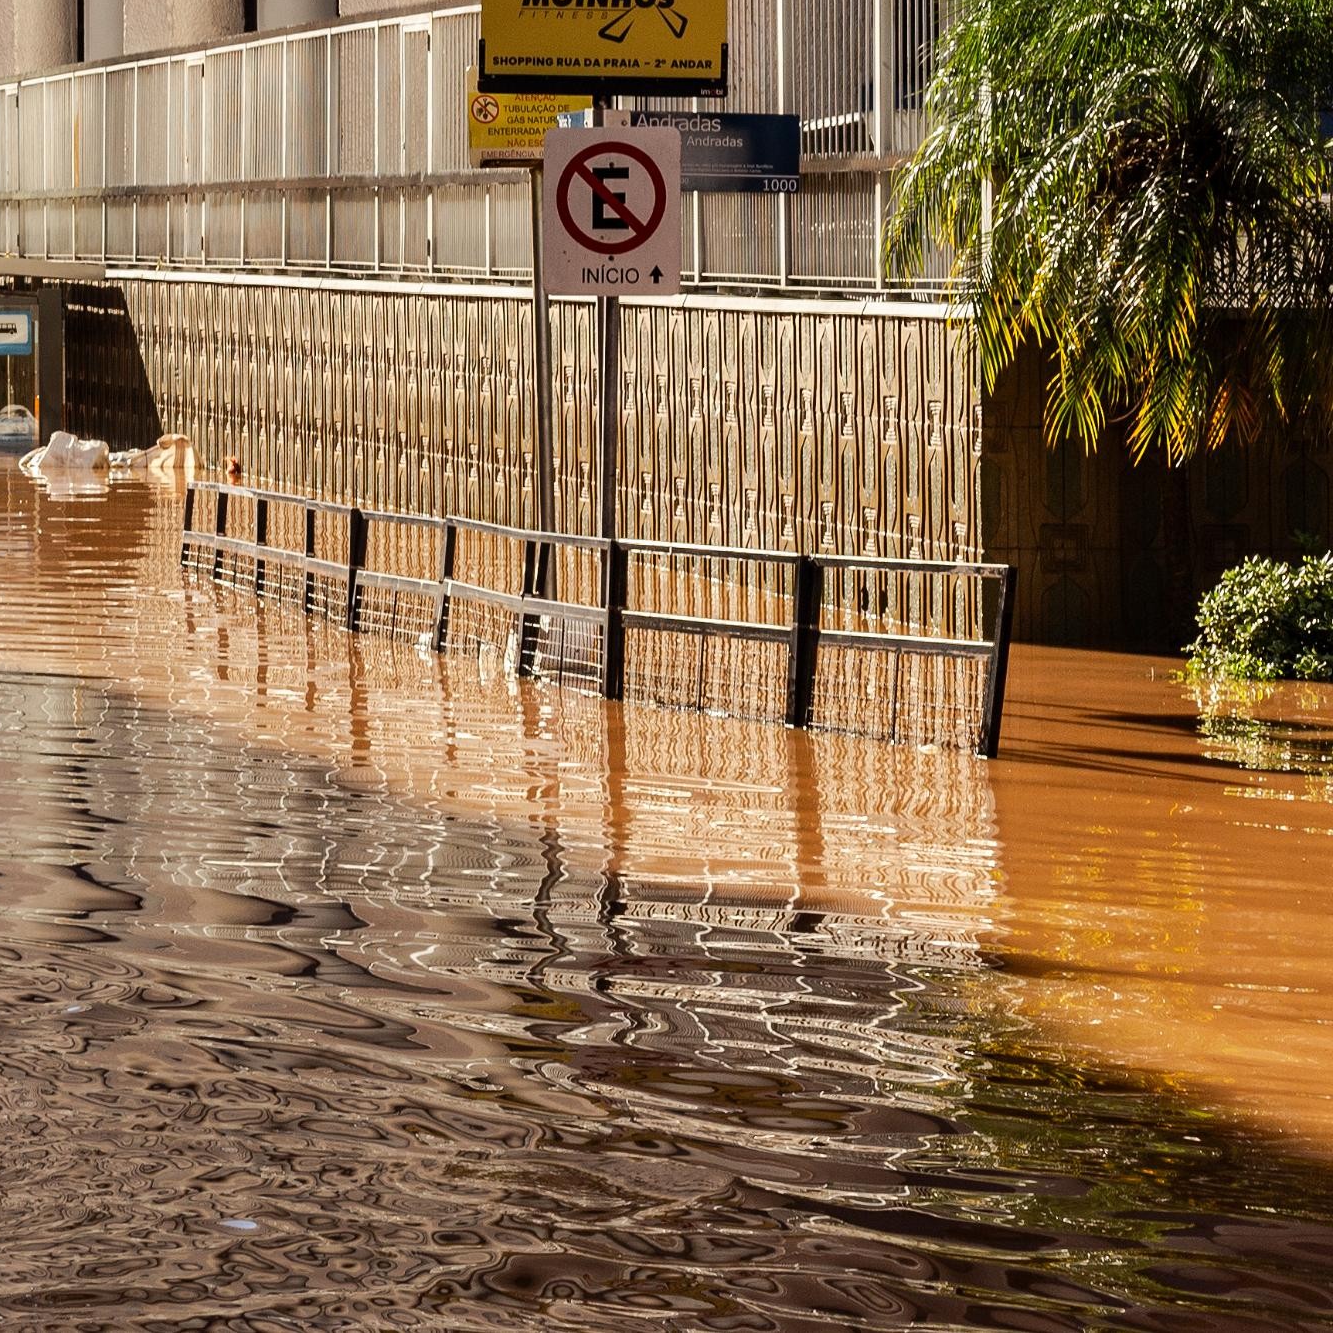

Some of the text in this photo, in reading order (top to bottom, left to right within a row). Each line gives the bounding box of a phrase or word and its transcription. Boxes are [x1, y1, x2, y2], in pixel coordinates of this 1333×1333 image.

[518, 10, 609, 20] FITNESS
[492, 56, 554, 67] SHOPPING
[556, 57, 581, 68] RUA
[584, 58, 600, 68] DA
[603, 58, 640, 68] PRAIA
[670, 60, 712, 69] ANDAR
[503, 104, 570, 114] TUBULAÇÃO DE
[507, 114, 525, 123] GÁS
[527, 116, 559, 124] NATUR
[636, 113, 722, 132] Andradas
[488, 128, 540, 136] ENTERRADA
[507, 138, 526, 147] NÃO
[686, 135, 743, 148] Andradas
[481, 149, 535, 158] EMERGÊNCIA
[763, 179, 797, 192] 1000
[592, 167, 630, 229] E
[582, 265, 640, 284] INÍCIO
